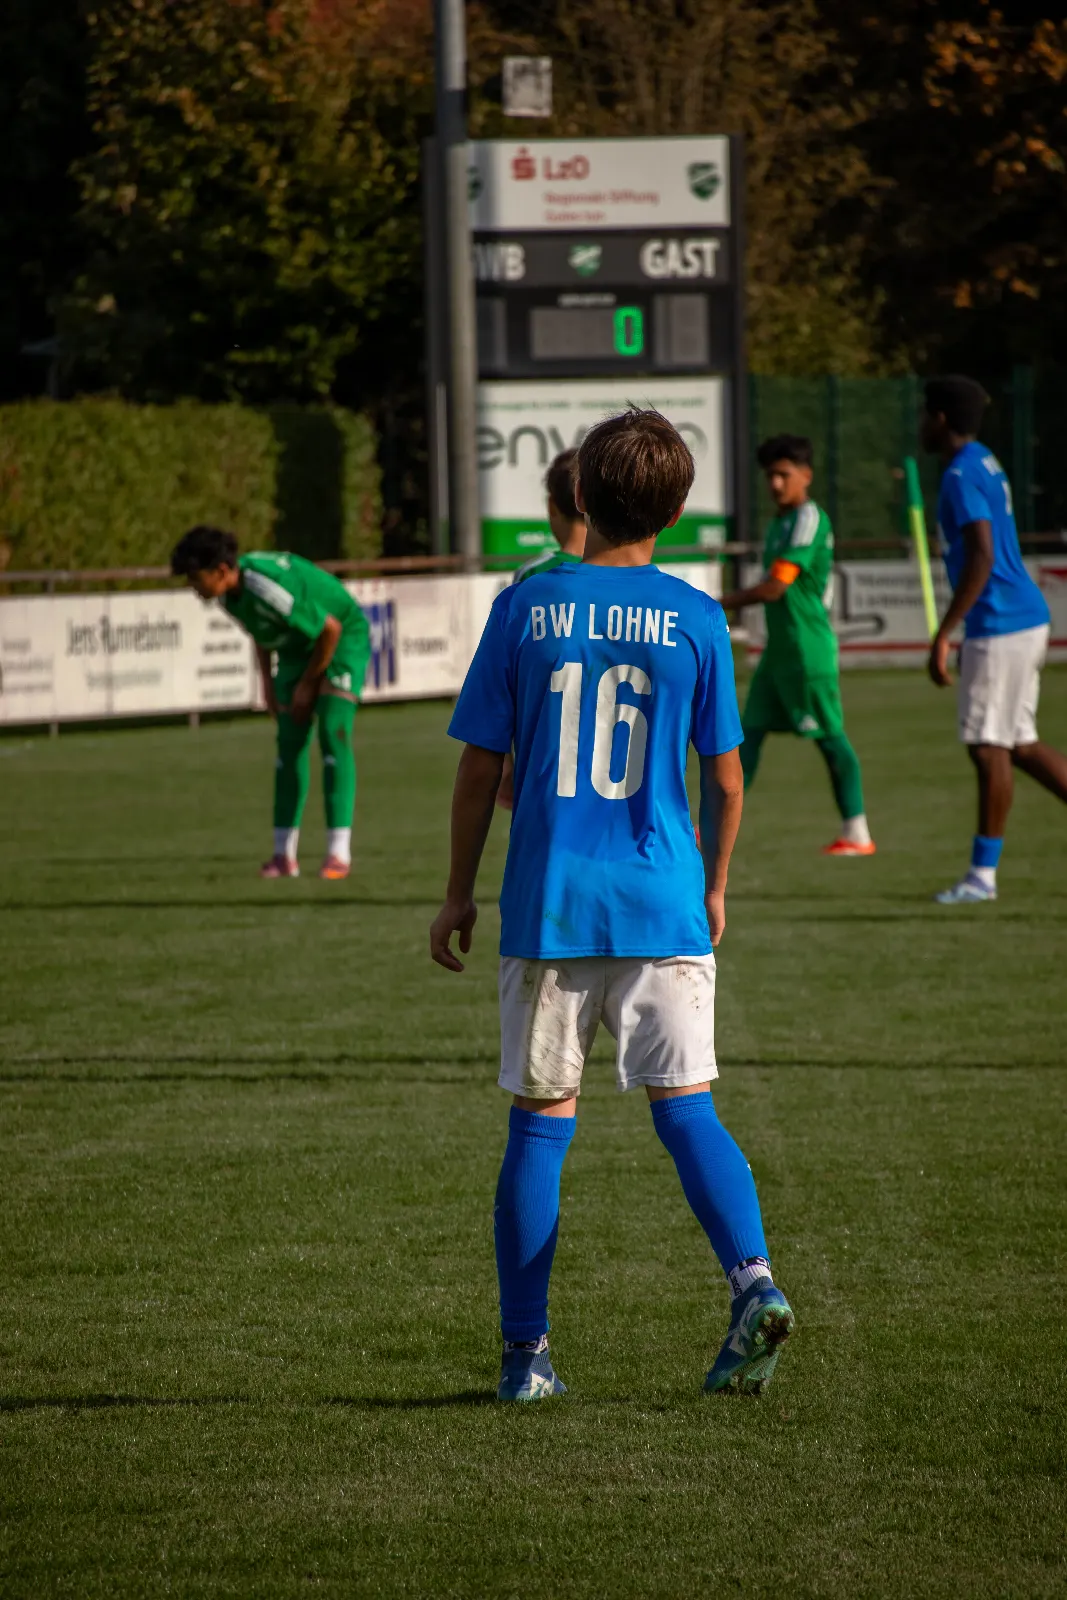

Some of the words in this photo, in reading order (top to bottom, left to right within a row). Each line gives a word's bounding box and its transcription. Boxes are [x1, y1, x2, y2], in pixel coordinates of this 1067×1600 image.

[640, 238, 720, 279] GAST
[613, 306, 644, 356] 0
[531, 602, 576, 641] BW
[588, 603, 679, 647] LOHNE
[550, 661, 652, 799] 16
